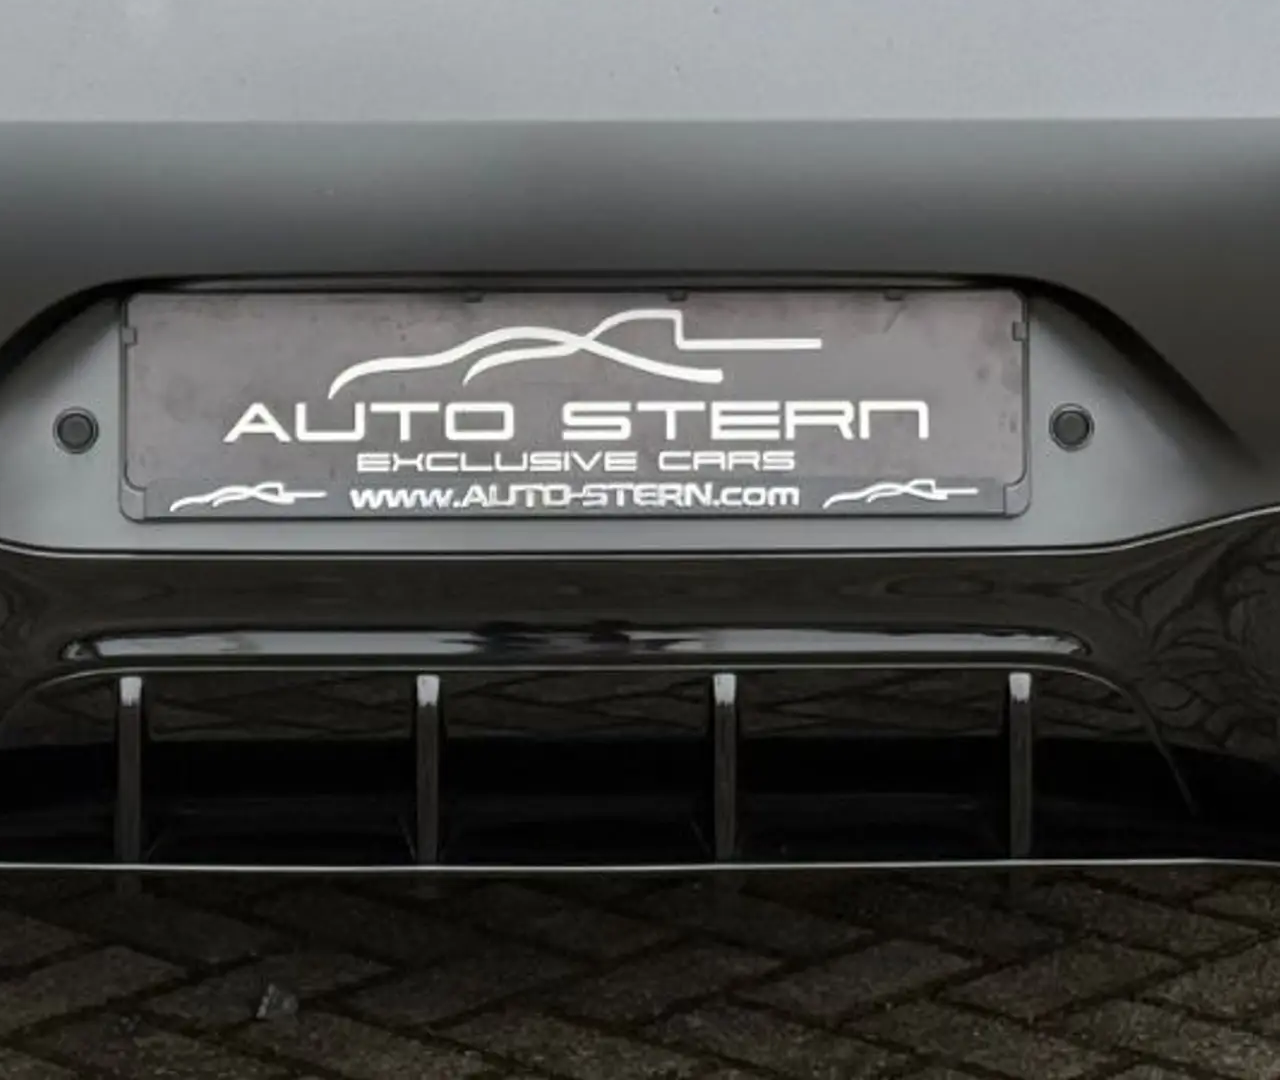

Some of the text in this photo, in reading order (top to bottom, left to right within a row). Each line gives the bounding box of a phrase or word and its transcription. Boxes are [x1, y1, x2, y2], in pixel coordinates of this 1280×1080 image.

[222, 400, 931, 443] AUTO STERN
[356, 450, 797, 473] EXCLUSIVE CARS
[349, 481, 800, 509] www.AUTO-STERN.com
